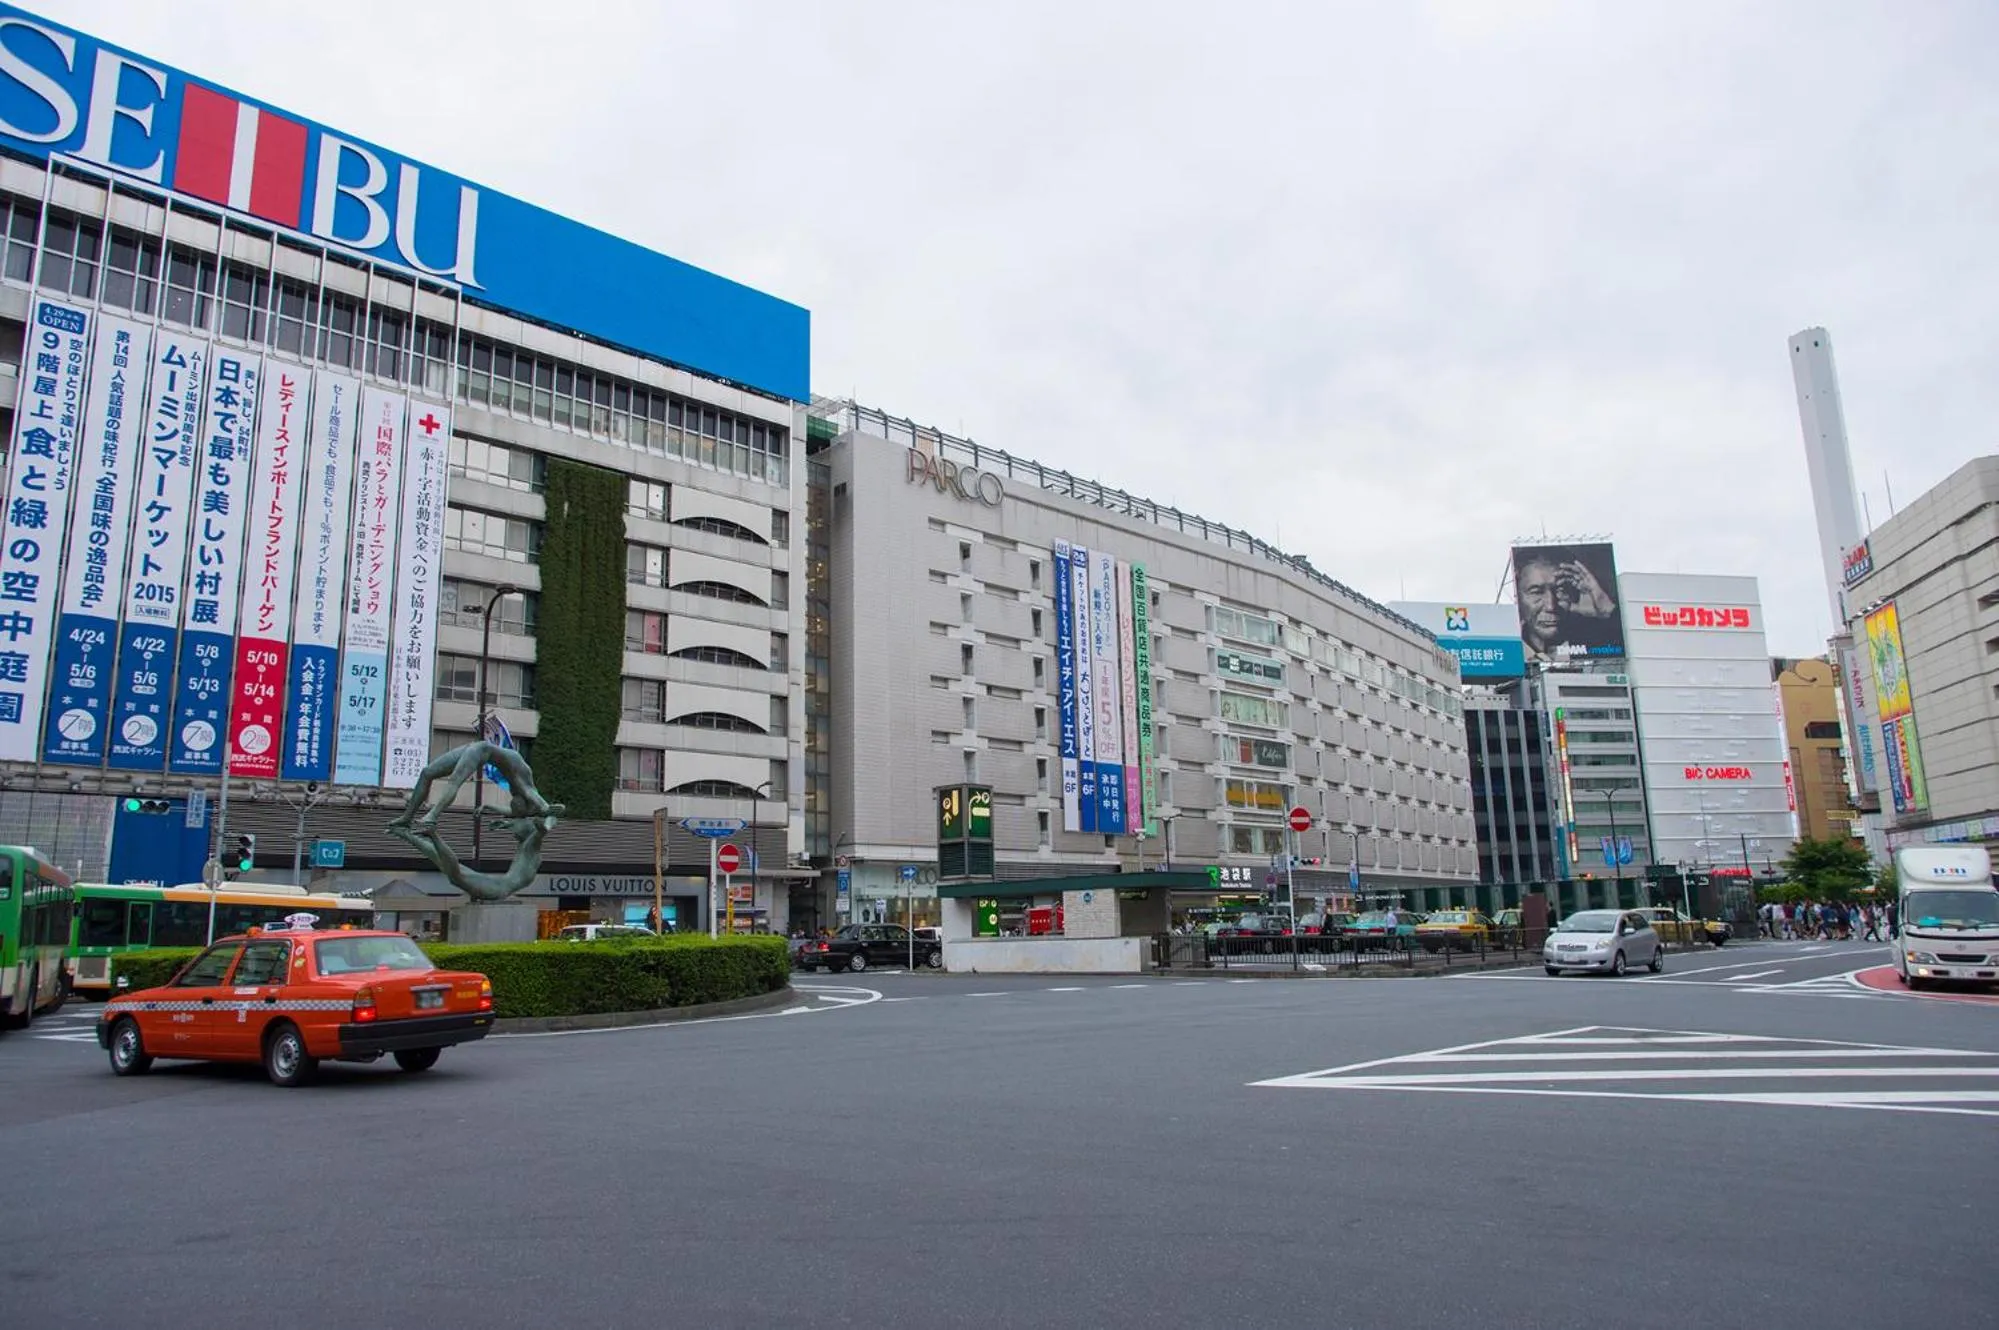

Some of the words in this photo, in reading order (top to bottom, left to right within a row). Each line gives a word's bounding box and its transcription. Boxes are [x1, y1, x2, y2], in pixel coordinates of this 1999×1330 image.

[0, 17, 486, 291] SEIBU
[44, 315, 80, 331] OPEN
[141, 345, 187, 577] ムーミンマーケット
[907, 447, 1004, 508] PARCO
[192, 357, 241, 625] 日本で最も美しい村展
[258, 373, 295, 633] レディースインポートブランドバーゲン
[134, 582, 175, 603] 2015
[1643, 605, 1751, 628] ビックカメラ
[69, 629, 105, 645] 4/24
[132, 637, 165, 652] 4/22
[195, 644, 219, 658] 5/8
[247, 651, 278, 666] 5/10
[70, 664, 96, 679] 5/6
[133, 671, 158, 685] 5/6
[351, 664, 378, 678] 5/12
[188, 677, 219, 692] 5/13
[244, 684, 275, 698] 5/14
[349, 695, 376, 709] 5/17
[295, 656, 316, 768] 入会金・年会費無料
[1684, 767, 1704, 779] BIC
[1705, 767, 1752, 779] CAMERA
[1064, 783, 1077, 793] 6F
[1082, 783, 1094, 796] 6F
[1220, 867, 1251, 881] 池袋駅
[549, 877, 596, 892] LOUIS
